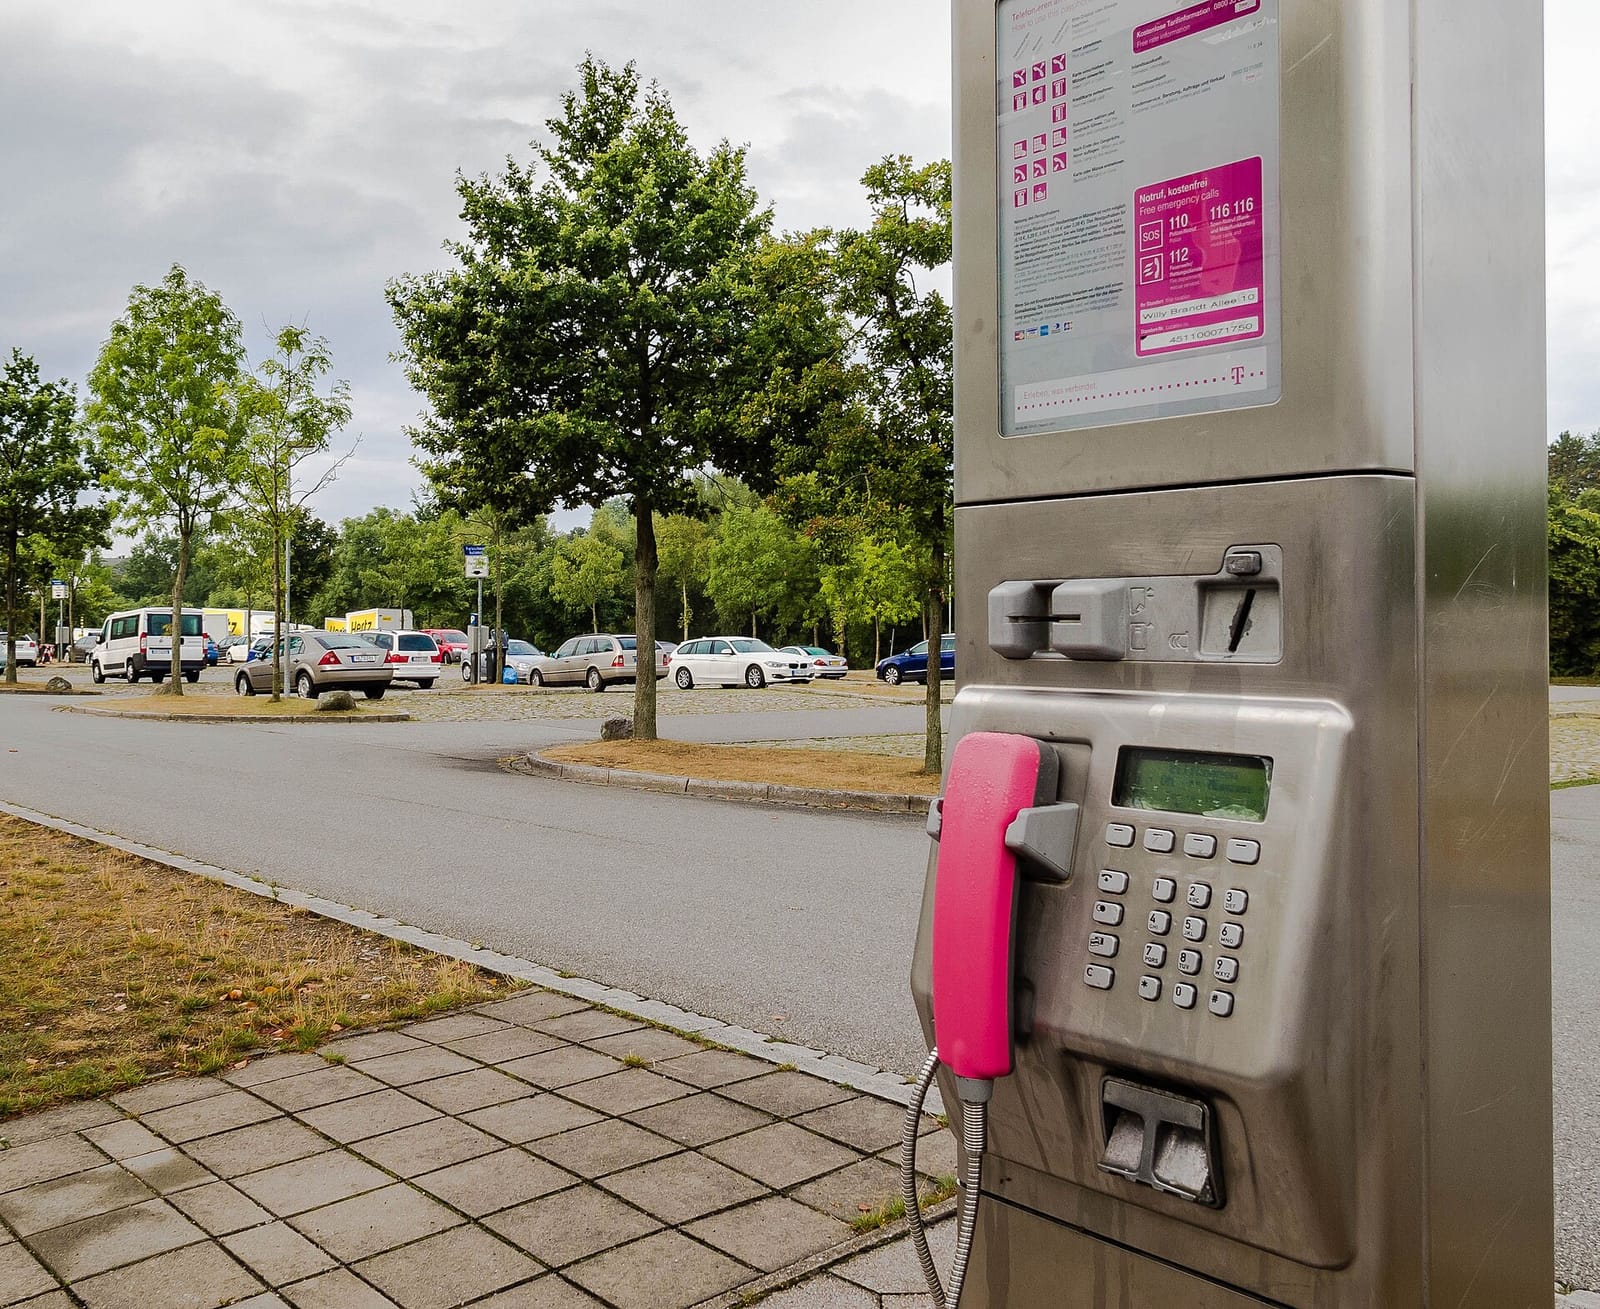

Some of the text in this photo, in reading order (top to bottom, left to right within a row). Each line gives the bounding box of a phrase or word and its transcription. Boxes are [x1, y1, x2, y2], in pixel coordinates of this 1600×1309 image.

[1136, 23, 1166, 38] Kostenlose
[1139, 177, 1207, 203] Notruf, kostenfrei
[1139, 188, 1219, 215] Free emergency calls
[1210, 197, 1253, 219] 116 116
[1142, 213, 1188, 242] SOS 110
[1169, 247, 1188, 263] 112
[1142, 293, 1254, 319] Willy Brandt Allee 10
[1169, 322, 1252, 342] 451100071750
[1231, 367, 1244, 385] T
[351, 620, 373, 634] Hertz
[1190, 886, 1196, 896] 2
[1226, 892, 1233, 902] 3
[1150, 914, 1156, 923] 4
[1185, 920, 1191, 930] 5
[1221, 926, 1228, 936] 6
[1146, 945, 1152, 955] 7
[1180, 952, 1187, 962] 8
[1217, 960, 1223, 970] 9
[1086, 967, 1093, 977] C
[1175, 986, 1182, 997] 0
